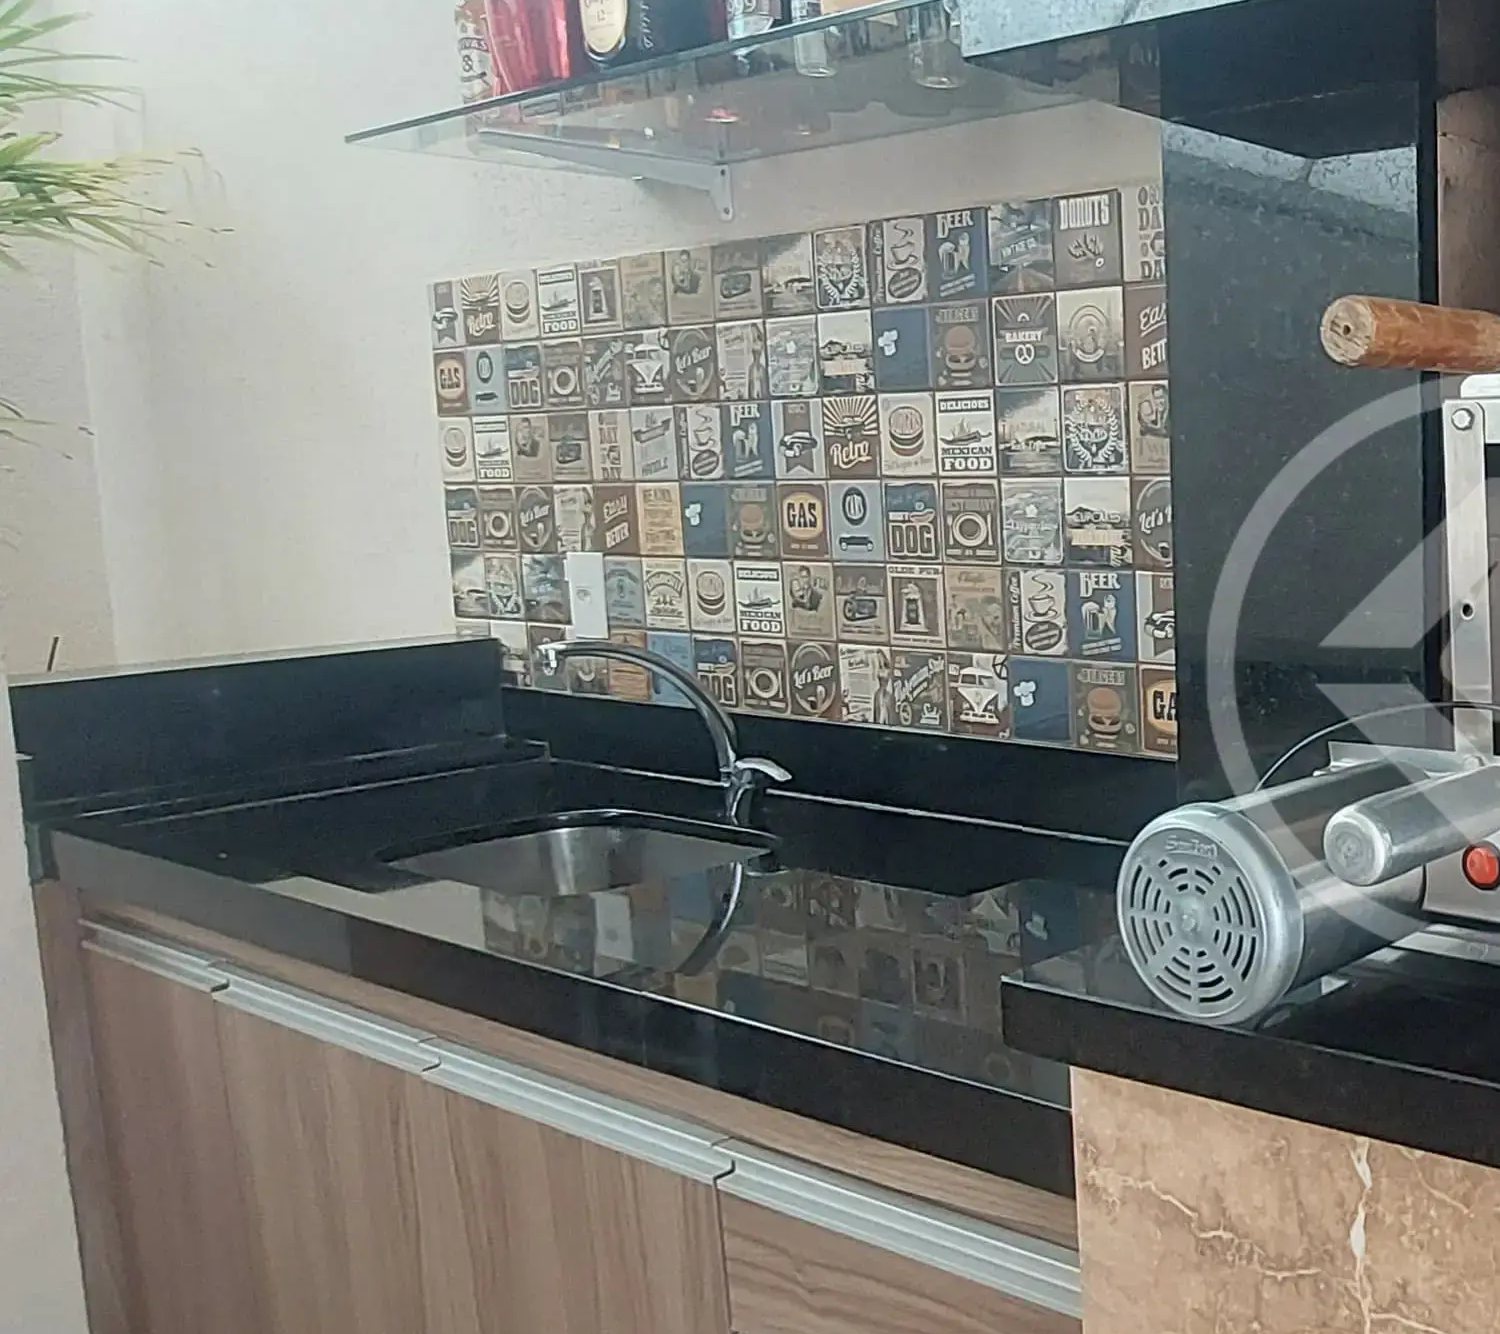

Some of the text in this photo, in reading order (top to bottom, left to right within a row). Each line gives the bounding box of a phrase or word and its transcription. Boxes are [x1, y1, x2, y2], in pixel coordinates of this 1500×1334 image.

[936, 210, 974, 239] BEER
[1059, 194, 1110, 230] DONUTS
[830, 439, 872, 469] Retro
[944, 457, 992, 471] FOOD
[786, 502, 818, 528] GAS
[891, 523, 934, 556] DOG
[1079, 571, 1121, 598] BEER
